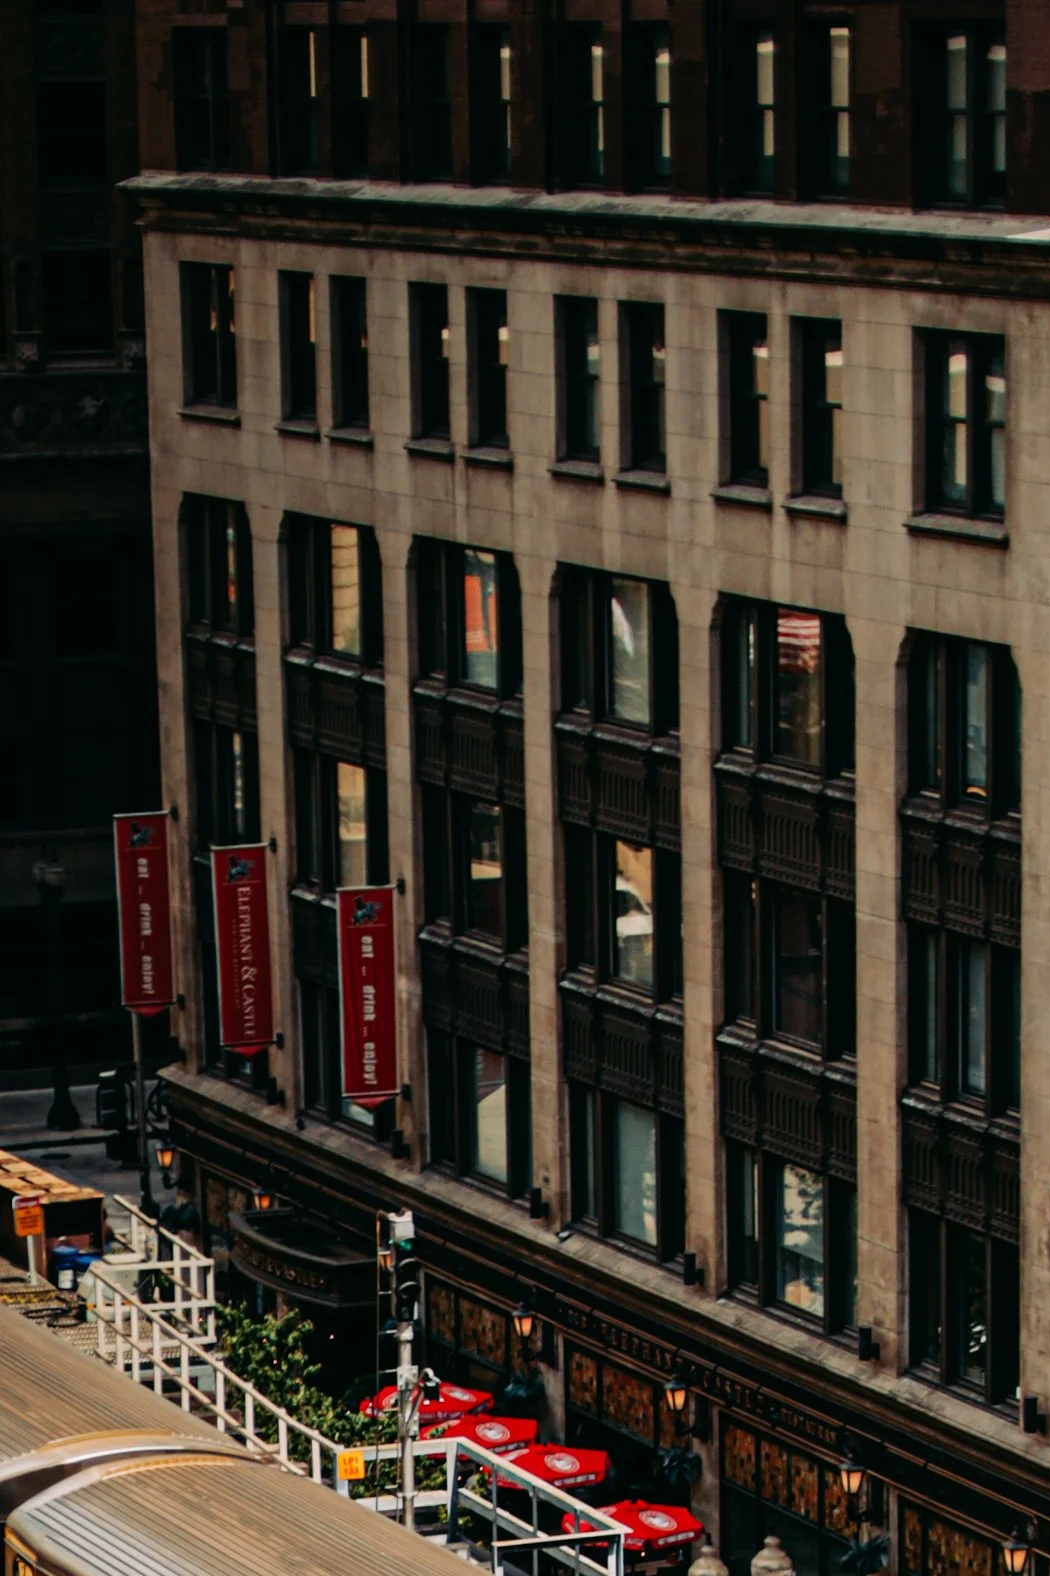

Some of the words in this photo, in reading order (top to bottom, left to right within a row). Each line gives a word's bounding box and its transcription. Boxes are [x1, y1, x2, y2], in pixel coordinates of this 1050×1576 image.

[137, 857, 149, 878] eat
[139, 902, 152, 936] drink
[237, 886, 252, 961] ELEPHANT
[361, 935, 374, 958] eat
[141, 955, 154, 994] enjoy!
[241, 965, 258, 981] &
[241, 984, 256, 1038] CASTLE
[362, 984, 376, 1022] drink
[363, 1041, 377, 1085] enjoy!
